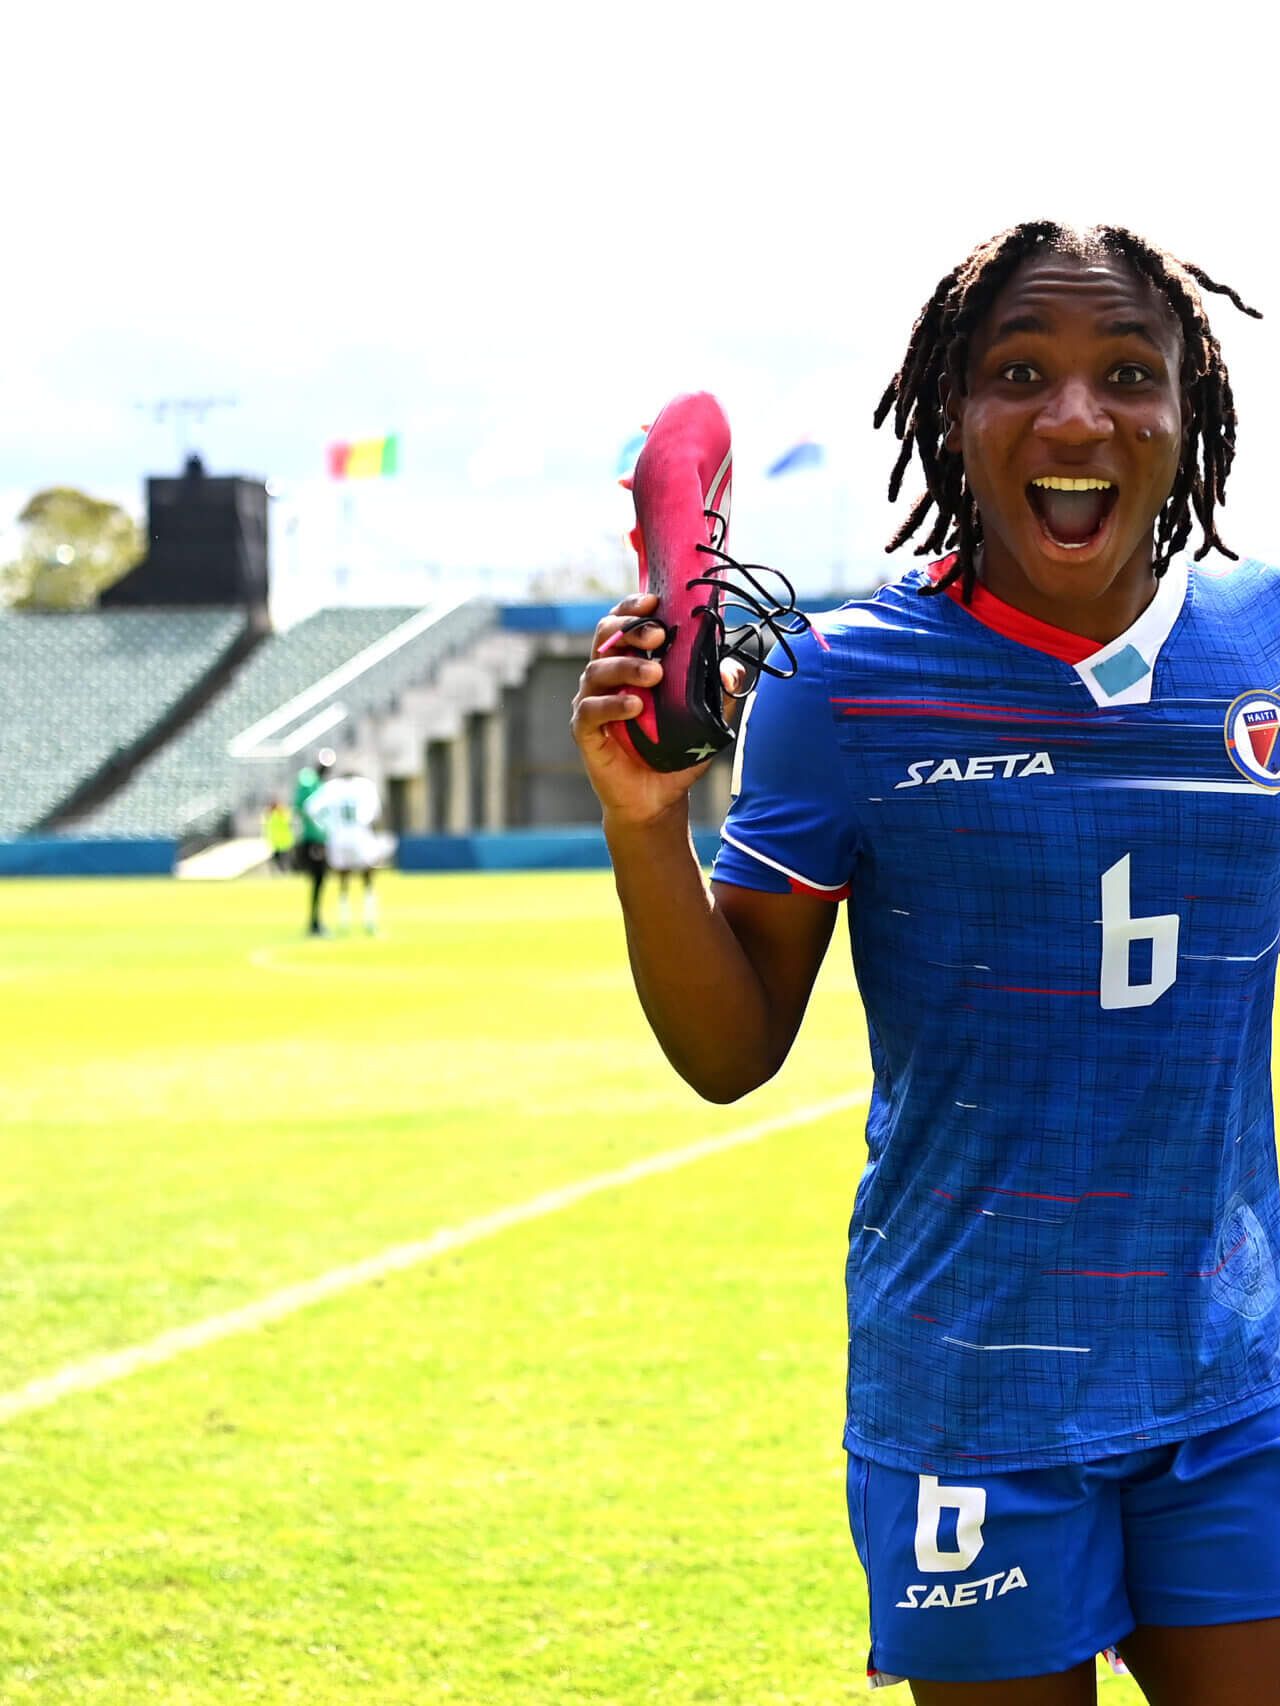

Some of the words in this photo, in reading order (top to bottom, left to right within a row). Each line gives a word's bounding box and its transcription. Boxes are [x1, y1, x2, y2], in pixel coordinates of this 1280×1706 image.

[1247, 711, 1275, 722] HAITI
[894, 752, 1055, 789] SAETA
[1100, 852, 1180, 1010] 6
[914, 1474, 987, 1573] 6
[895, 1566, 1028, 1608] SAETA
